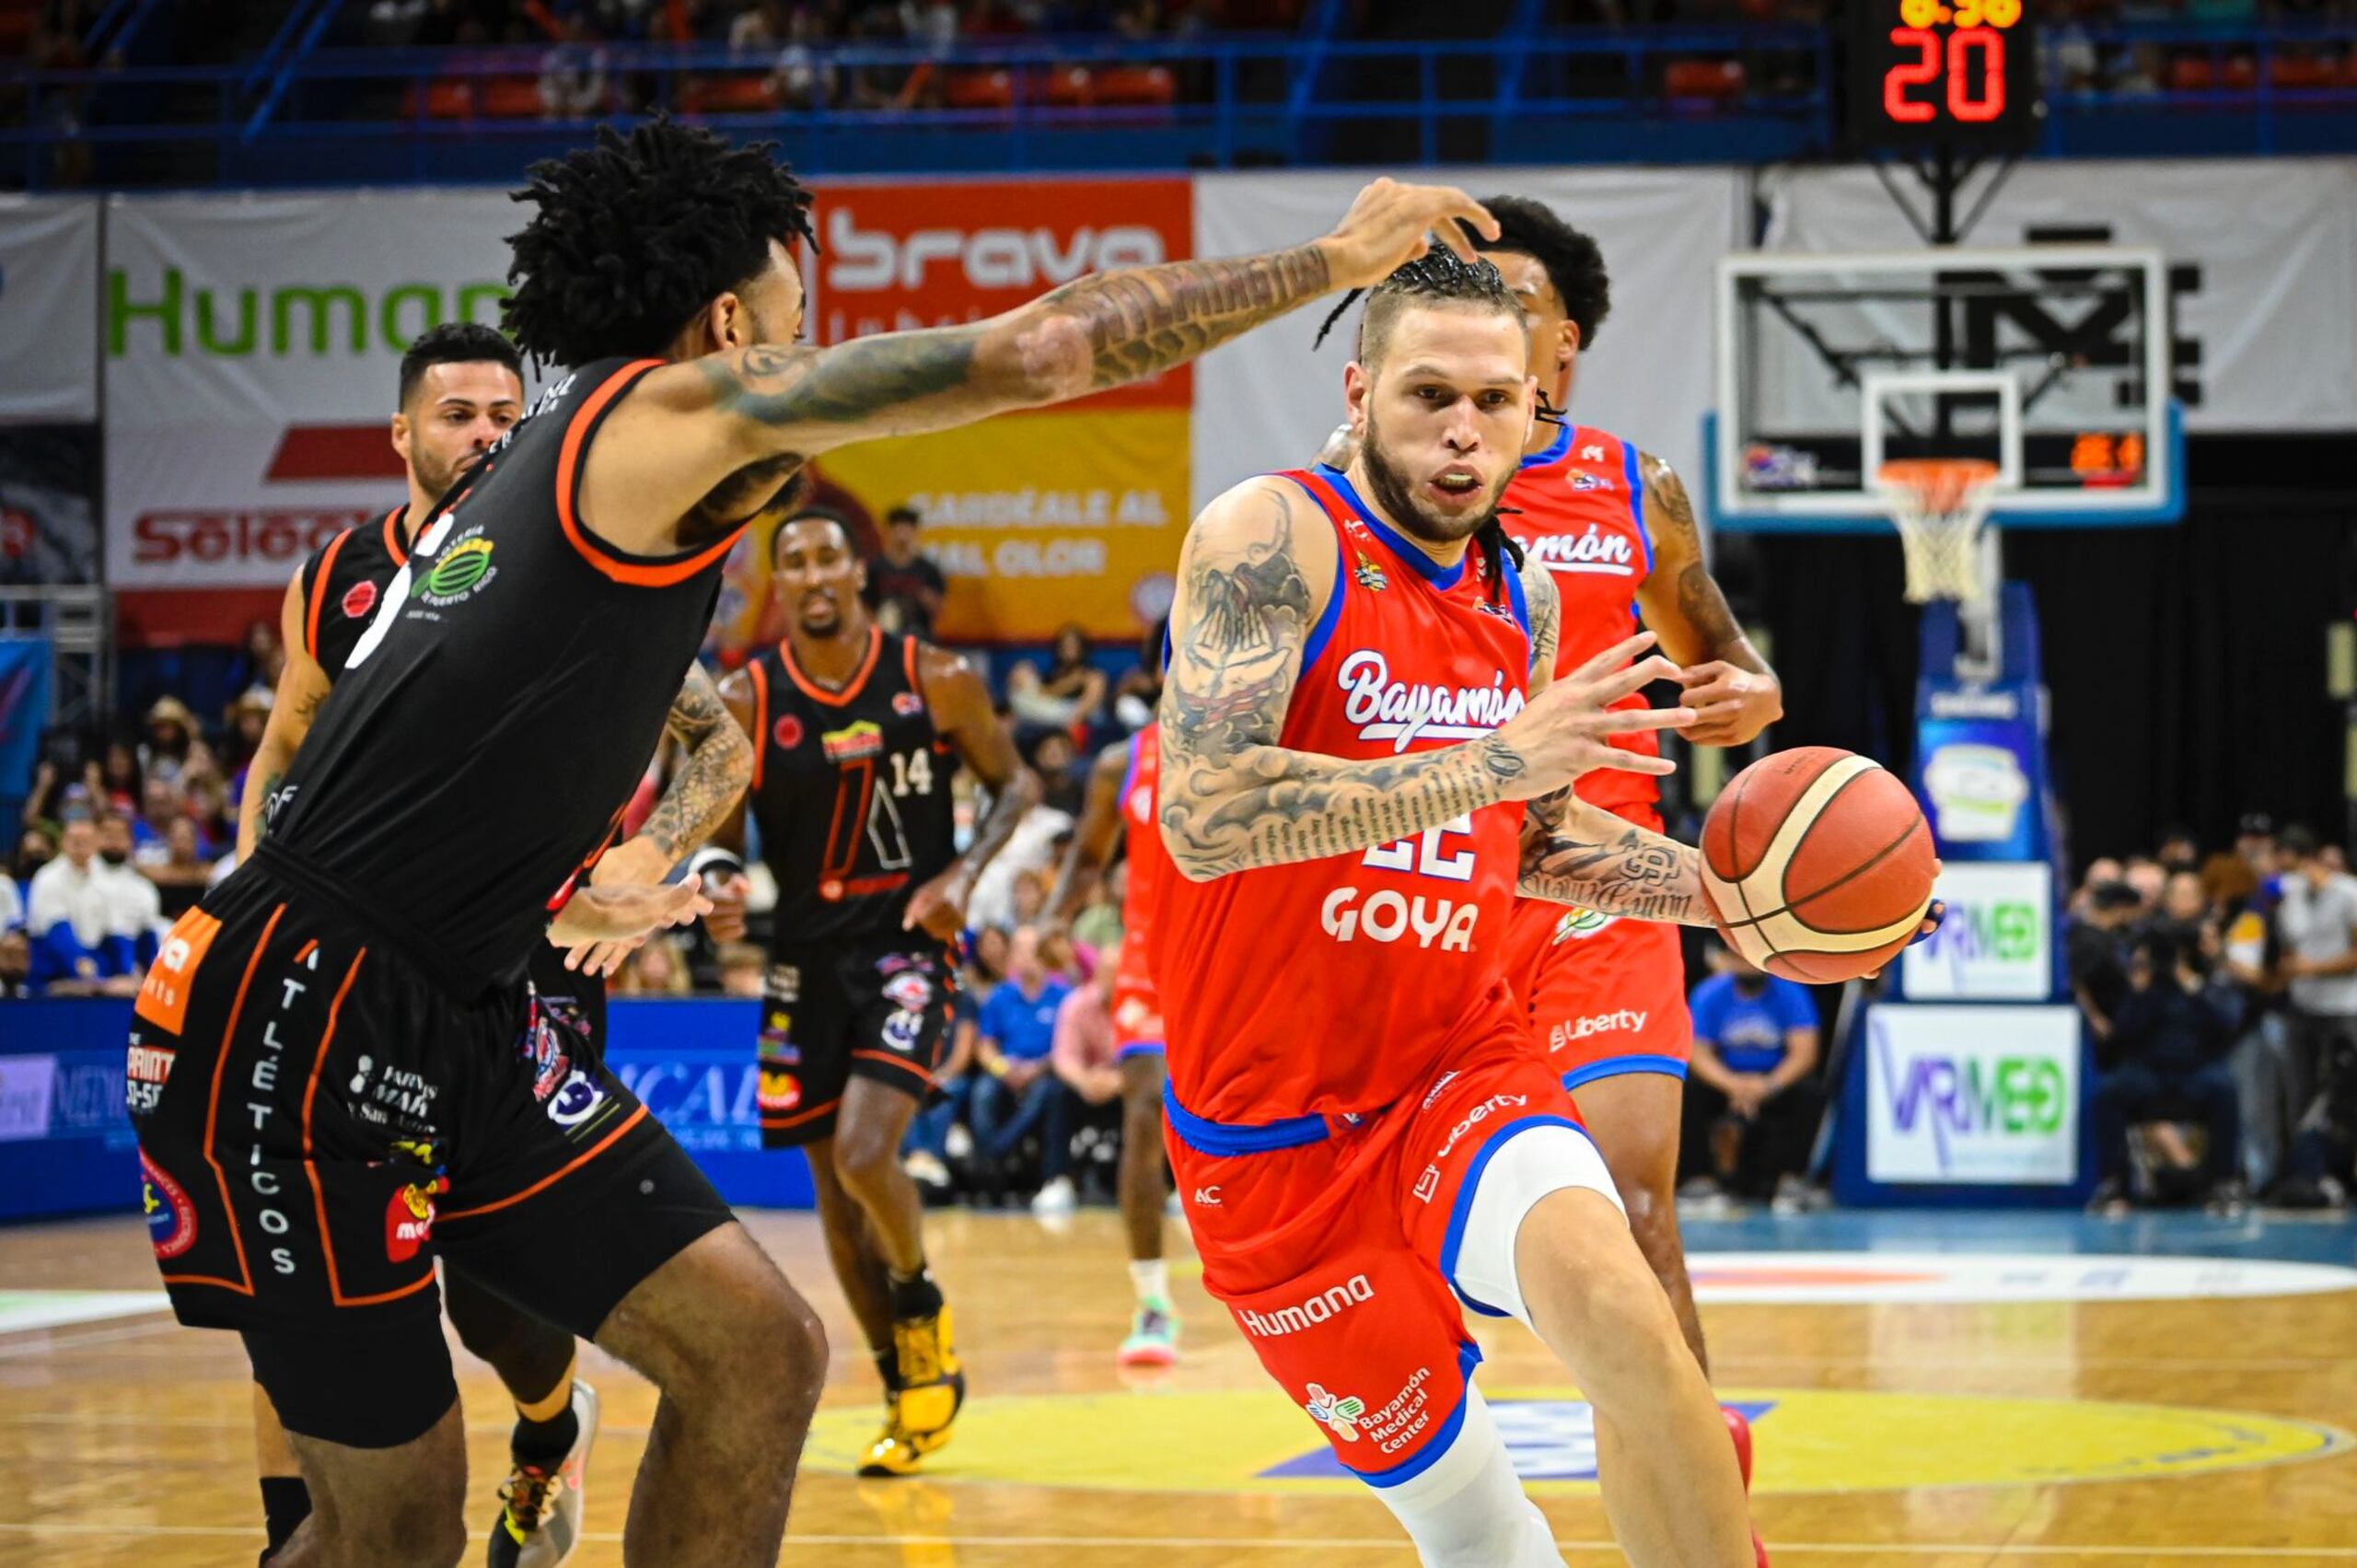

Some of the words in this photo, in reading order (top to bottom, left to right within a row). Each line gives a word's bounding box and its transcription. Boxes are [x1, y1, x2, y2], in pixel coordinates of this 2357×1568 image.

[1883, 26, 2005, 122] 20
[107, 265, 517, 359] Human
[890, 748, 933, 797] 14
[1321, 886, 1480, 953] GOYA
[1565, 1008, 1647, 1041] Liberty
[1437, 1094, 1527, 1157] Liberty
[1193, 1185, 1222, 1204] AC
[1238, 1273, 1375, 1337] Humana
[1358, 1366, 1432, 1430] Bayamón
[1369, 1388, 1429, 1443] Medical
[1380, 1410, 1430, 1454] Center
